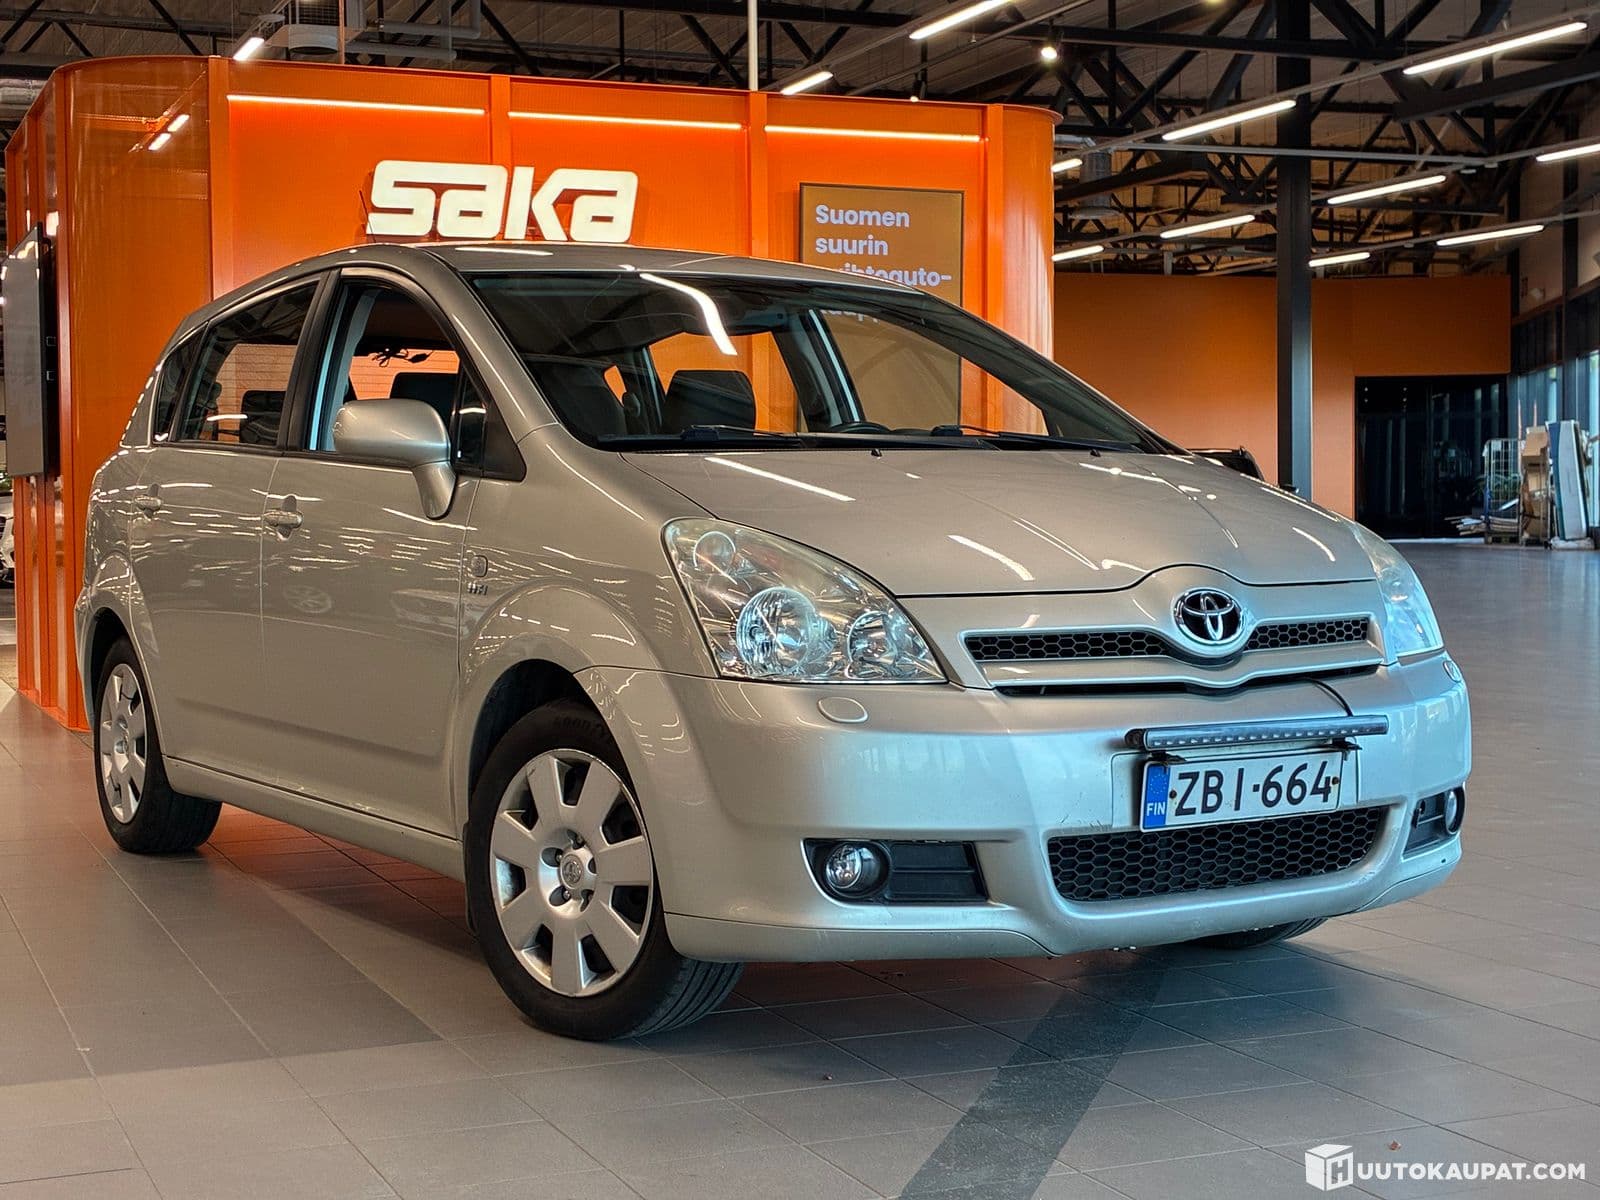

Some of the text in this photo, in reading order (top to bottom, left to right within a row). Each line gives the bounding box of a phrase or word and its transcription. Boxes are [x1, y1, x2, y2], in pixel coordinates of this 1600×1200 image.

[815, 204, 910, 228] Suomen
[815, 234, 889, 256] suurin
[1174, 761, 1332, 817] ZBI-664
[1146, 801, 1166, 817] FIN
